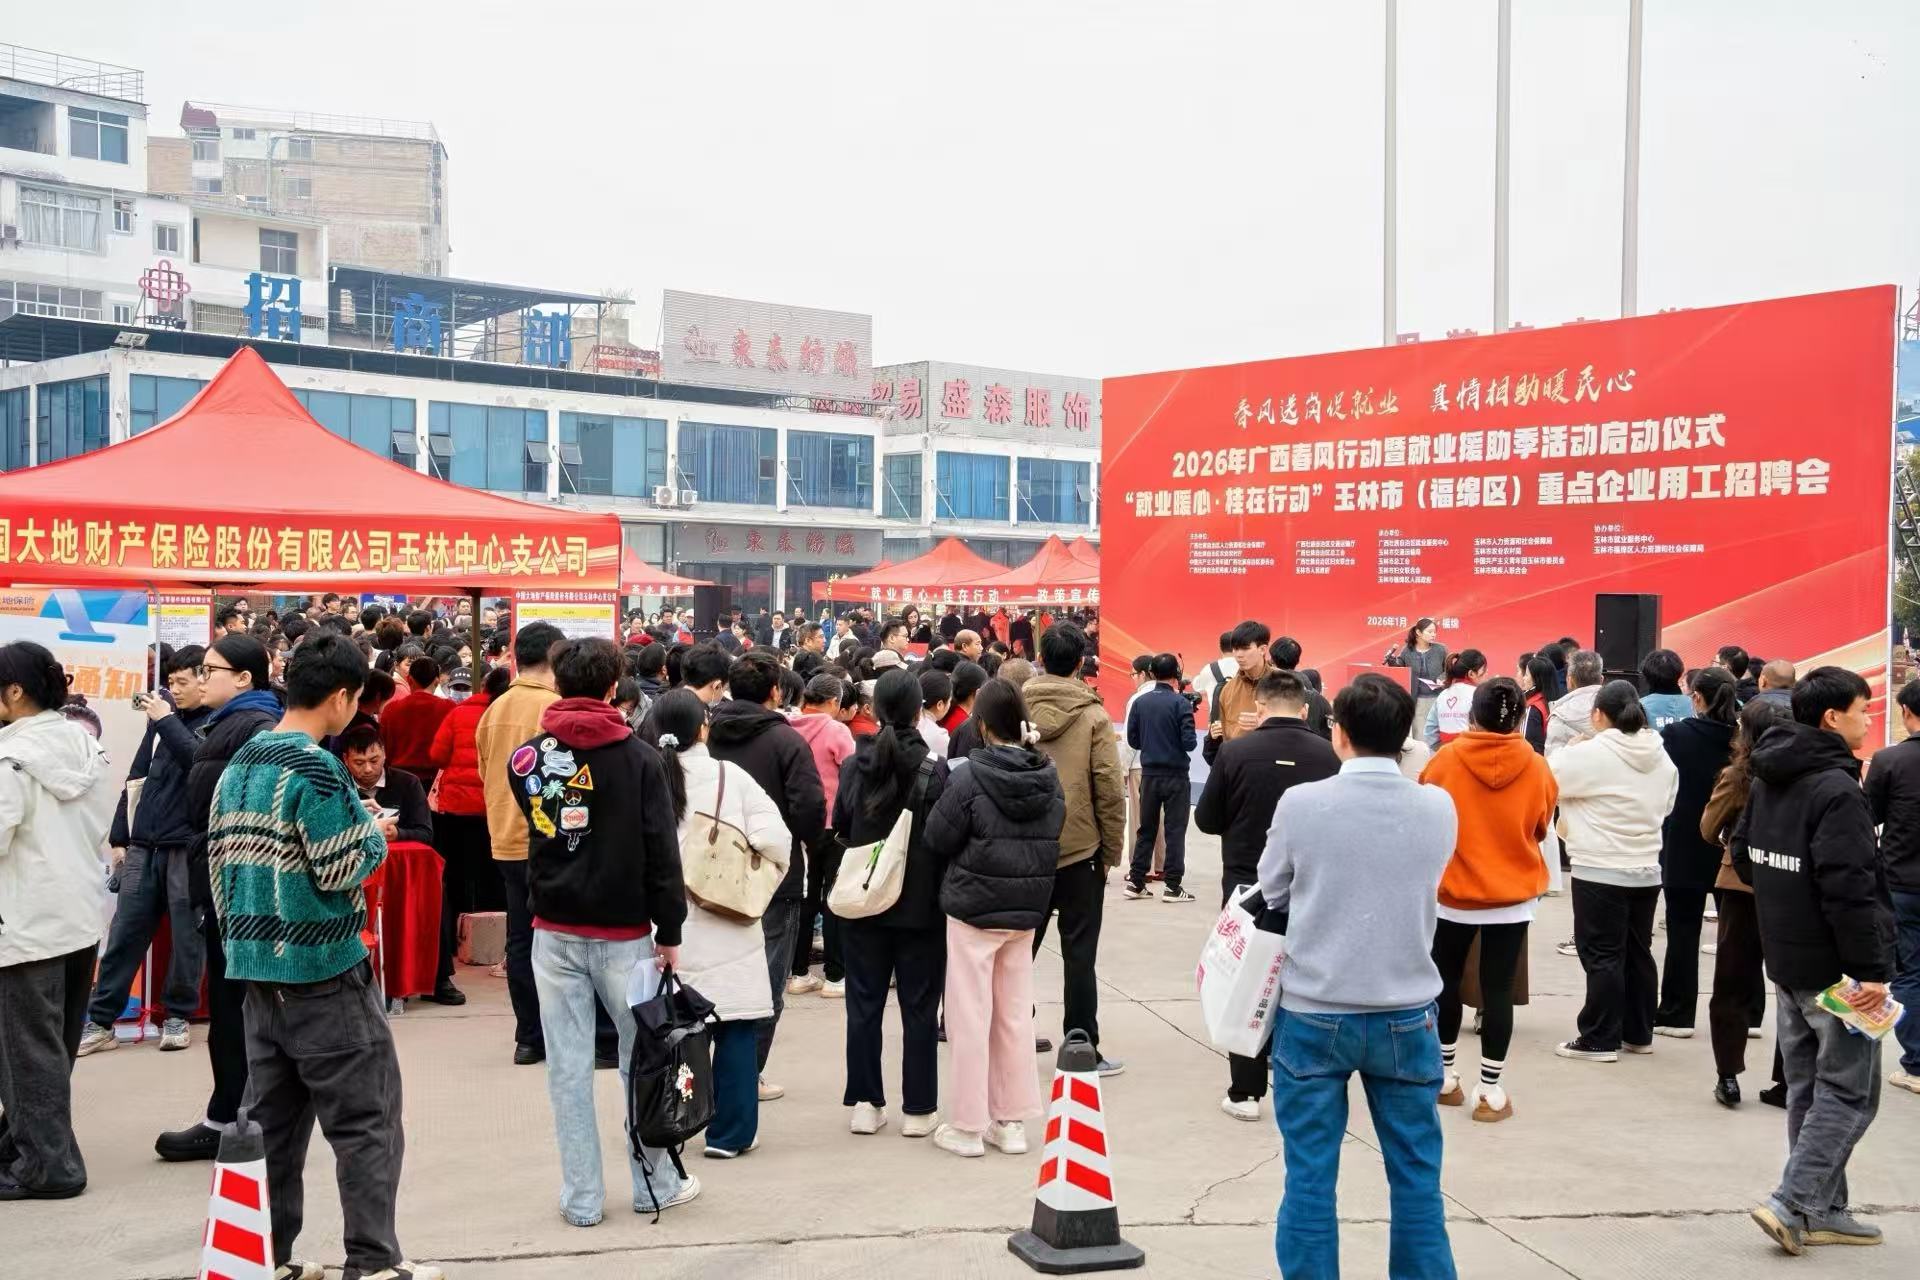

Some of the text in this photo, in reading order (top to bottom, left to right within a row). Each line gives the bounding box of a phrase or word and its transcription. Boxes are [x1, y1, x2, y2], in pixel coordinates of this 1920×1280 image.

[244, 272, 572, 367] 招商部
[941, 378, 1102, 431] 盛森服饰
[1233, 364, 1636, 429] 春风送岗促就业 真情相助暖民心
[1172, 413, 1726, 478] 2026年广西春风行动暨就业援助季活动启动仪式
